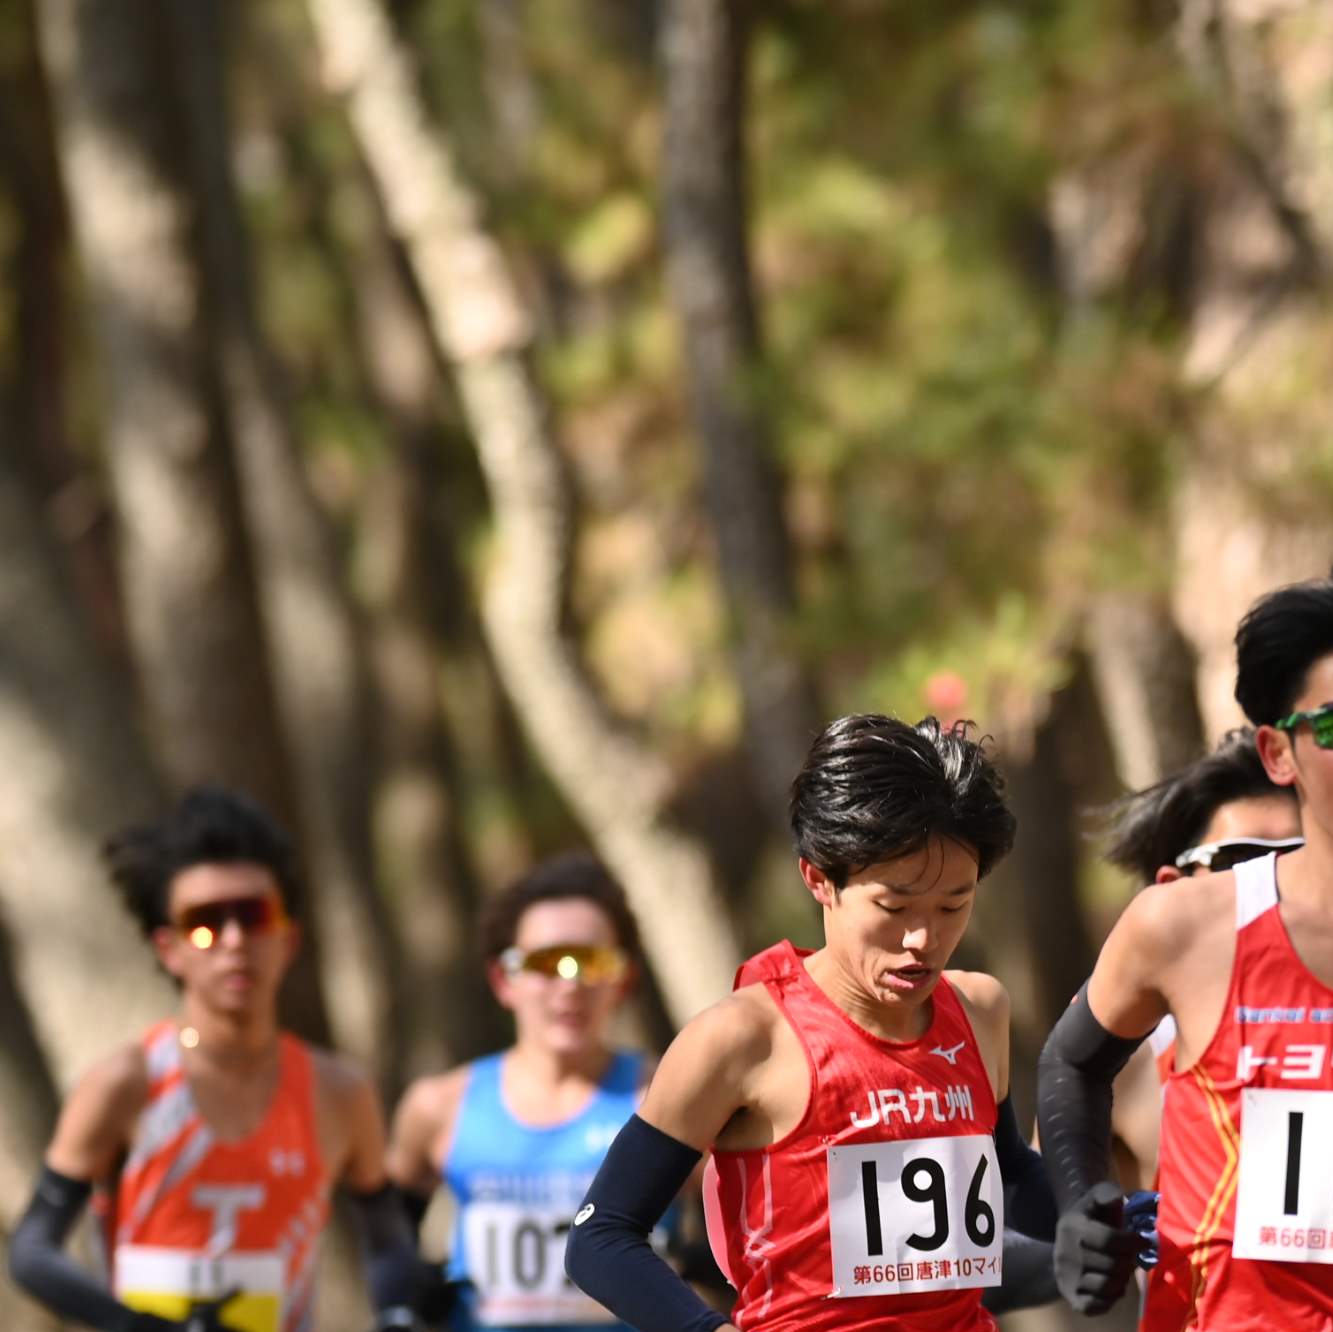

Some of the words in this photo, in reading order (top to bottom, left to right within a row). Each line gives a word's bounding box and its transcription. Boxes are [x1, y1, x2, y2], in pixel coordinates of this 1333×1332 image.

[850, 1084, 974, 1128] JR九州
[861, 1153, 995, 1256] 196
[853, 1256, 1000, 1284] 第66回唐津10マイ
